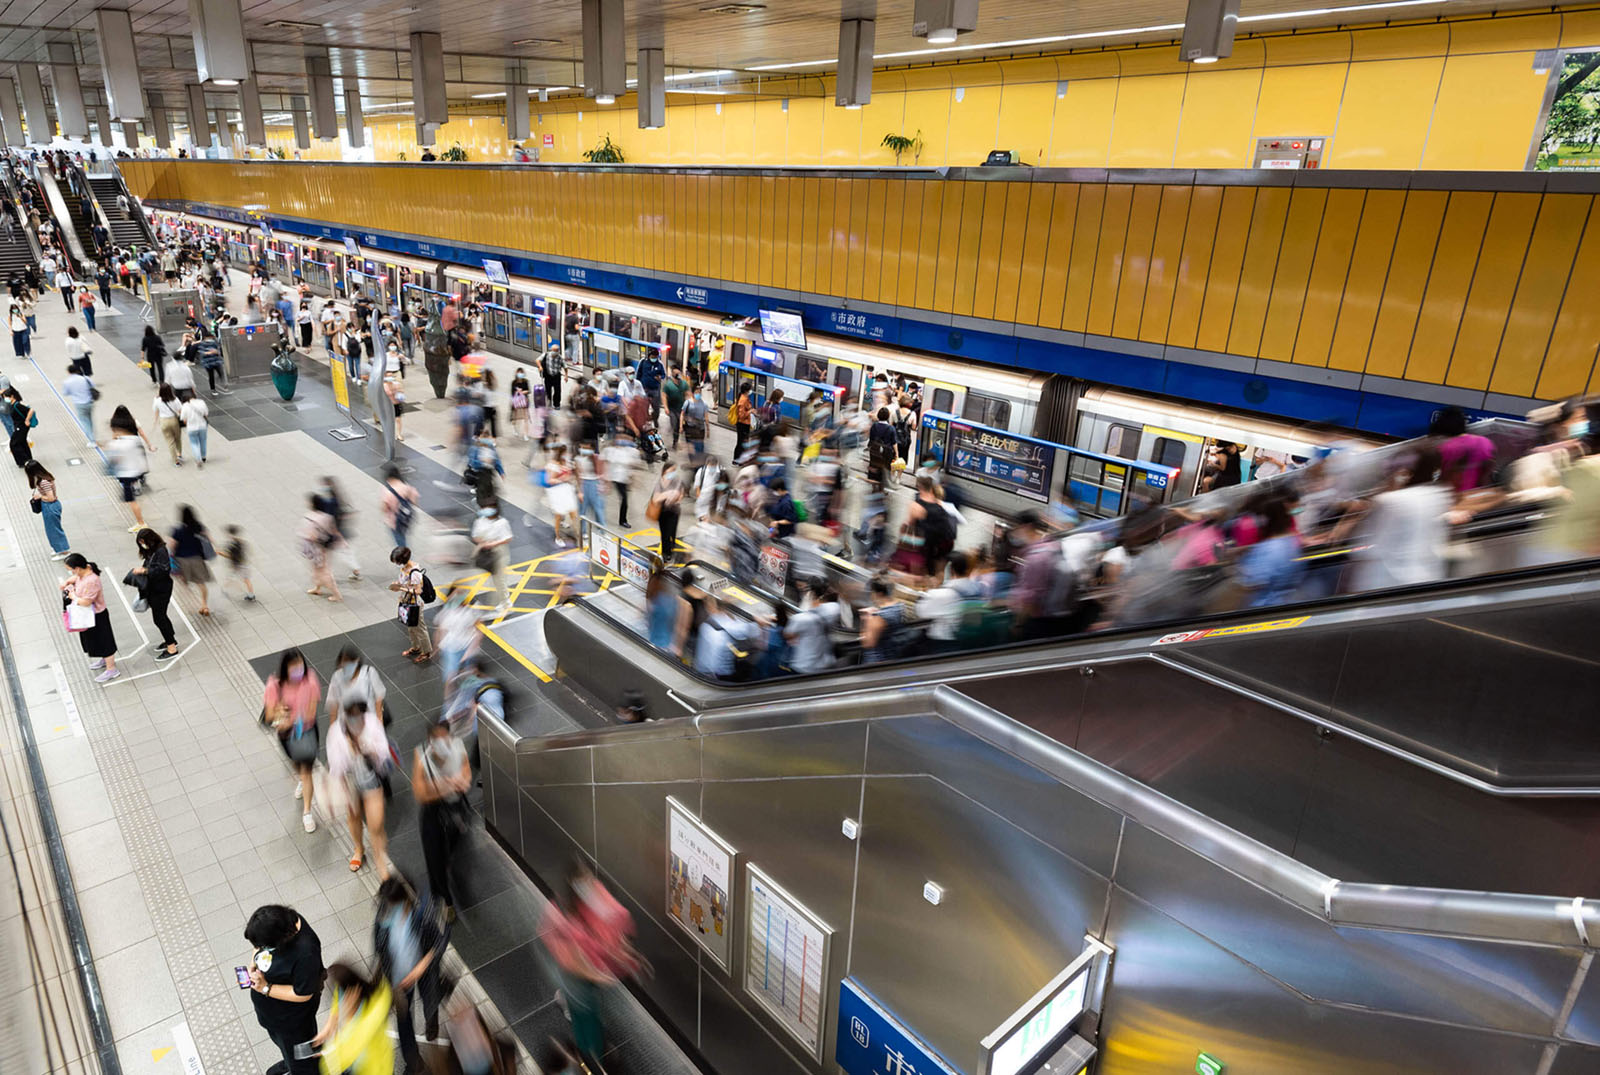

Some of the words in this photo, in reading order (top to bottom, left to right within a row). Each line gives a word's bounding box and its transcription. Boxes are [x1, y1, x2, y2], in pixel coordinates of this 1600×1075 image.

[838, 312, 866, 327] 市政府
[1158, 476, 1167, 487] 5
[855, 1020, 865, 1036] BL
[855, 1031, 865, 1044] 18
